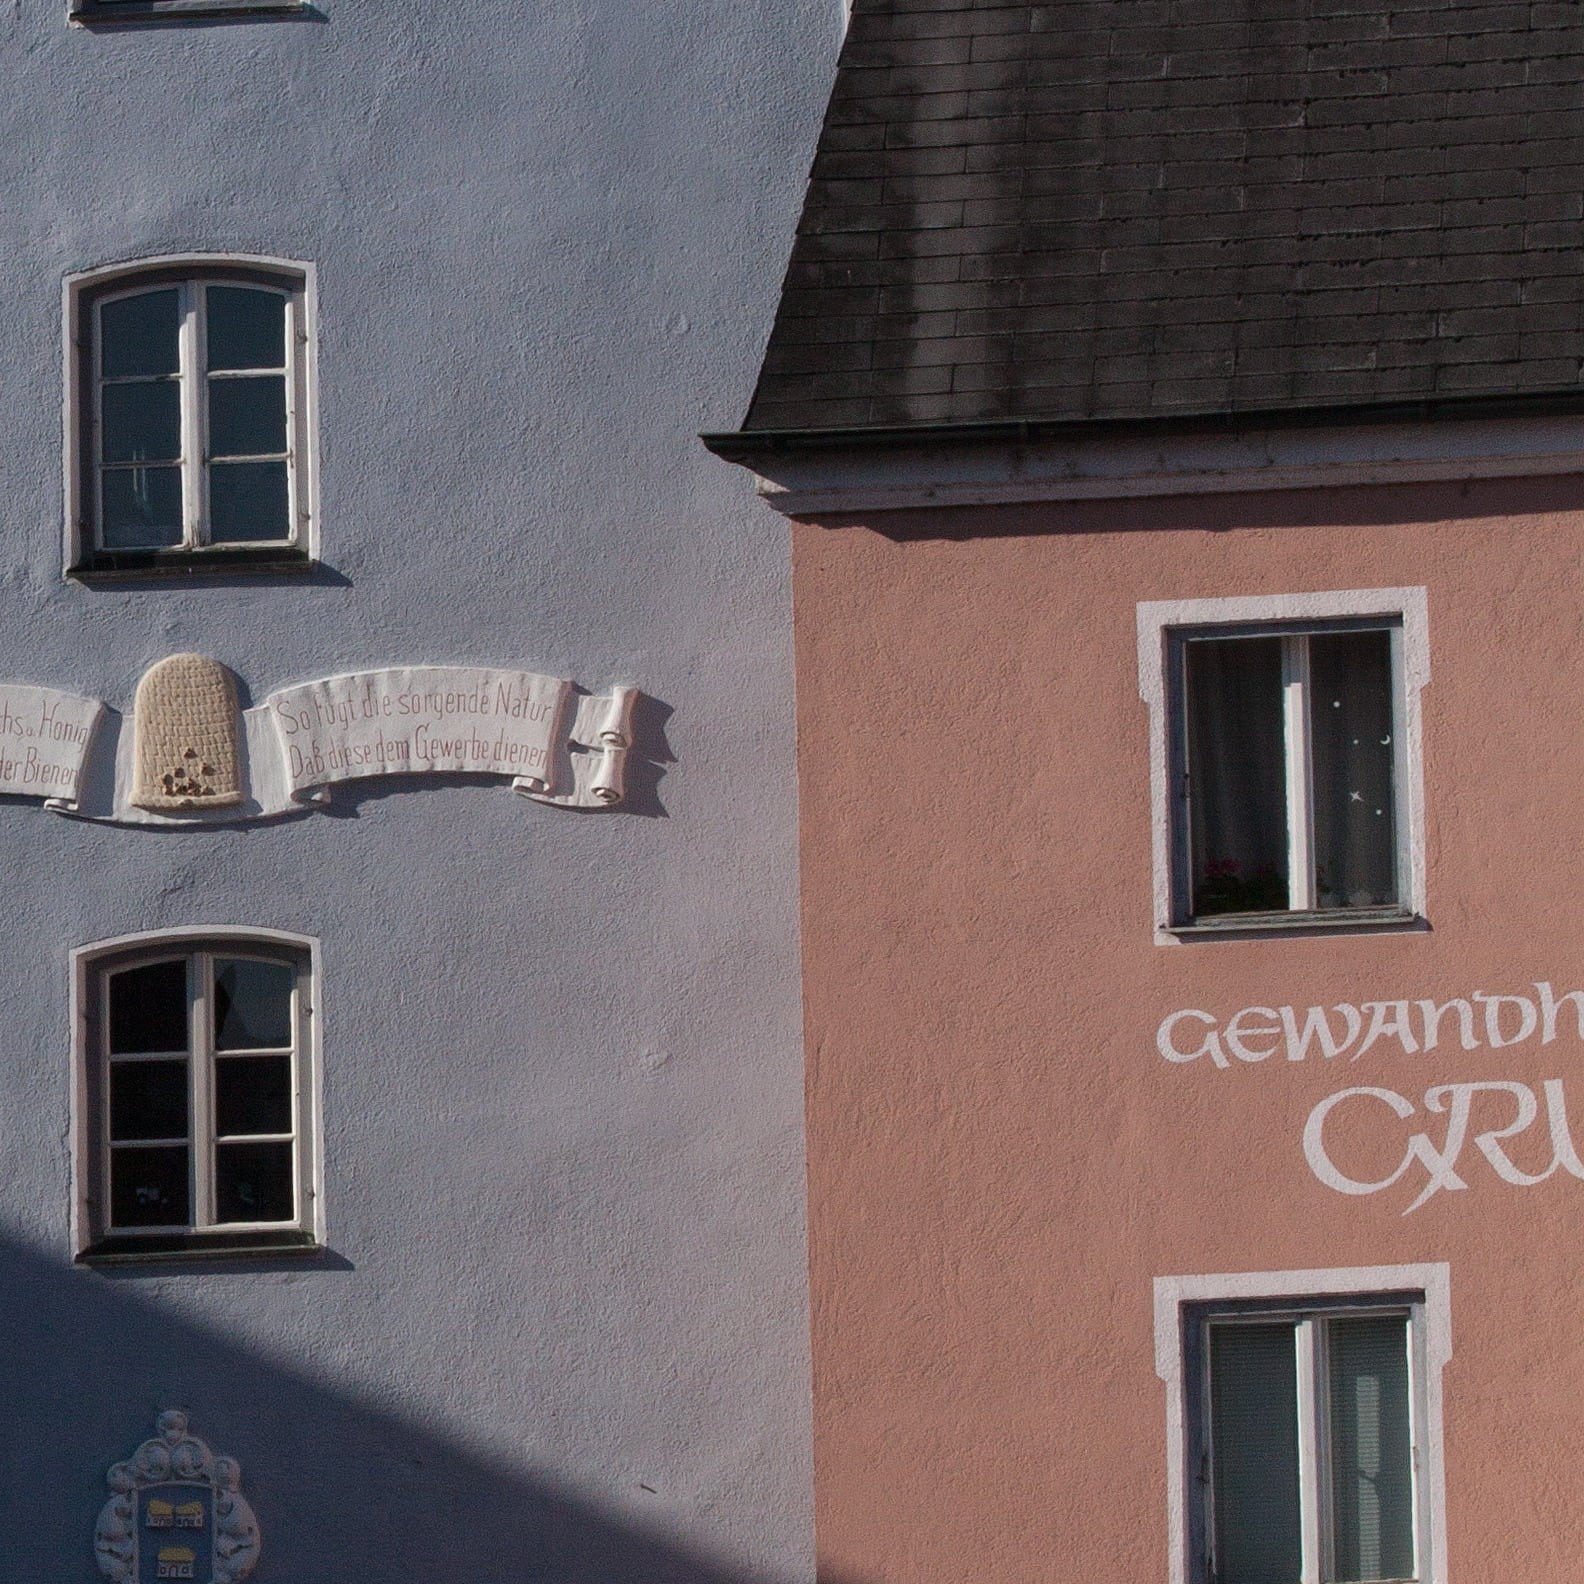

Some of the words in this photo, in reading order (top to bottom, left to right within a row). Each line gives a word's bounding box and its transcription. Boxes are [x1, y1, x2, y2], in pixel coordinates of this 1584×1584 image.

[38, 699, 90, 752] Honig
[276, 699, 311, 736] So
[362, 680, 392, 720] die
[398, 685, 488, 721] sorgende
[494, 681, 553, 723] Natur
[23, 746, 80, 786] Bienen
[289, 741, 327, 780] Daß
[328, 735, 371, 769] diese
[376, 729, 410, 764] dem
[414, 722, 489, 761] Gewerbe
[492, 727, 549, 767] dienen
